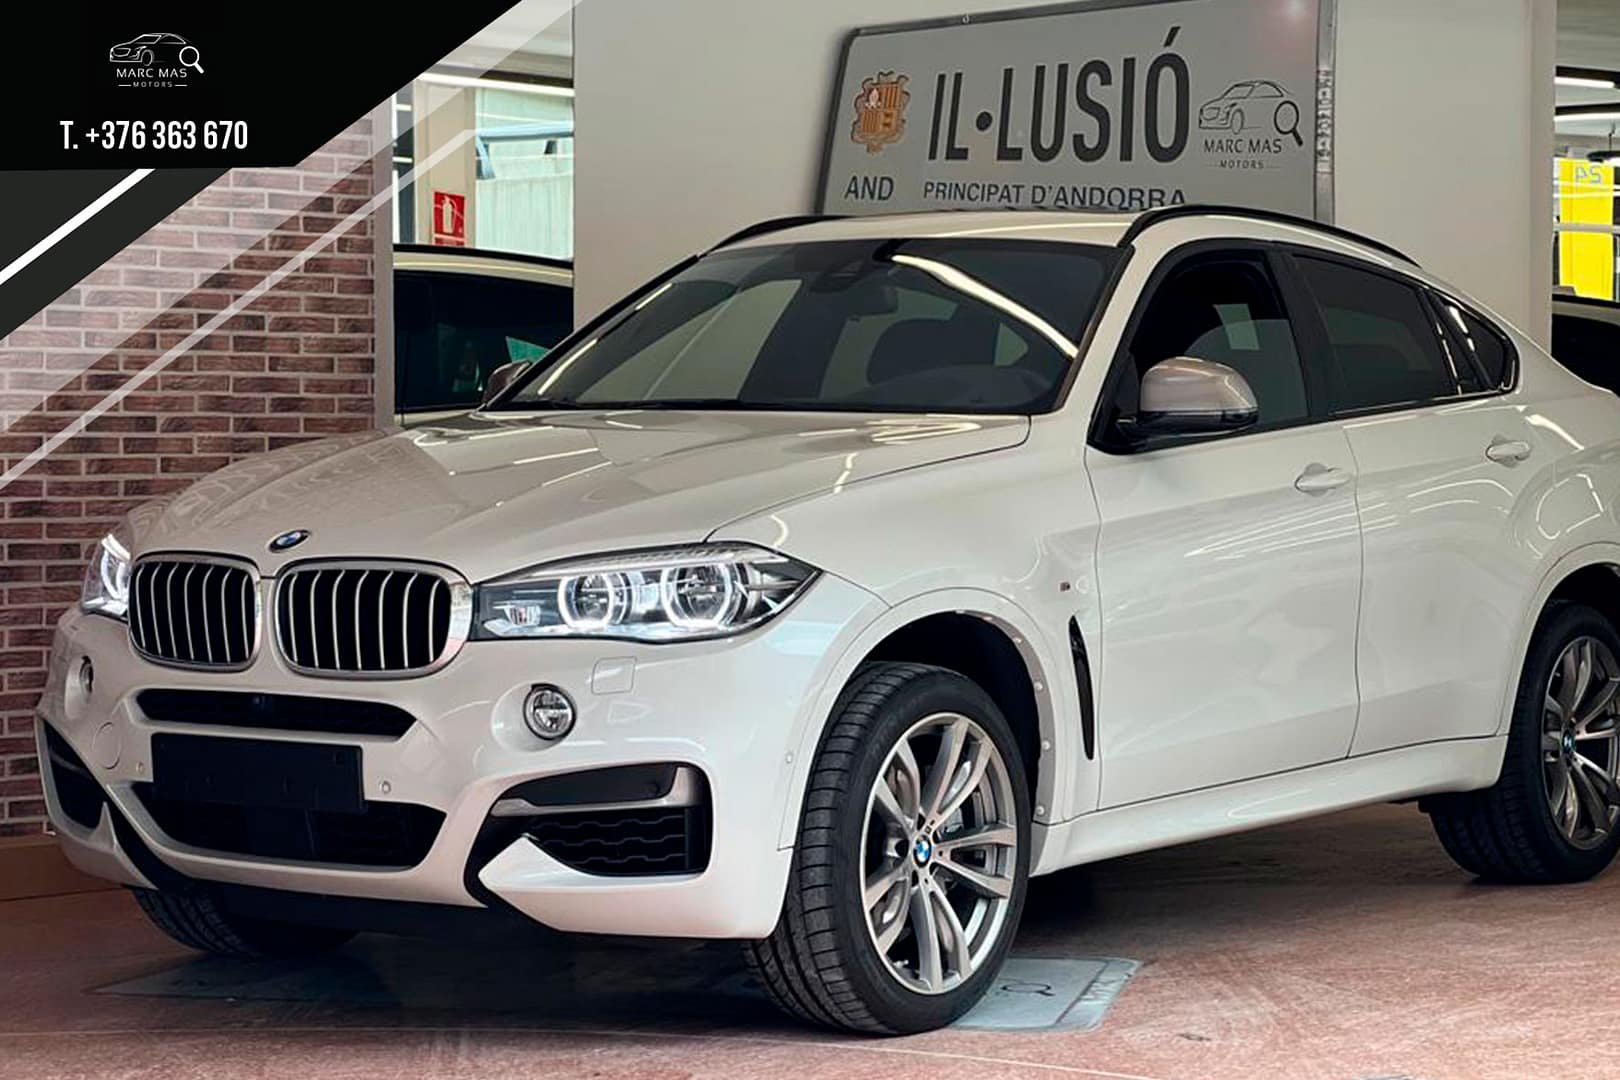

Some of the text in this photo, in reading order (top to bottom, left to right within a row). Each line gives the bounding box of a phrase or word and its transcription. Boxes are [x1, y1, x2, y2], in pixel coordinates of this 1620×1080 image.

[1204, 139, 1283, 154] MARC MAS
[1220, 160, 1264, 169] MOTORS
[844, 175, 895, 201] AND
[923, 181, 1025, 204] PRINCIPAT
